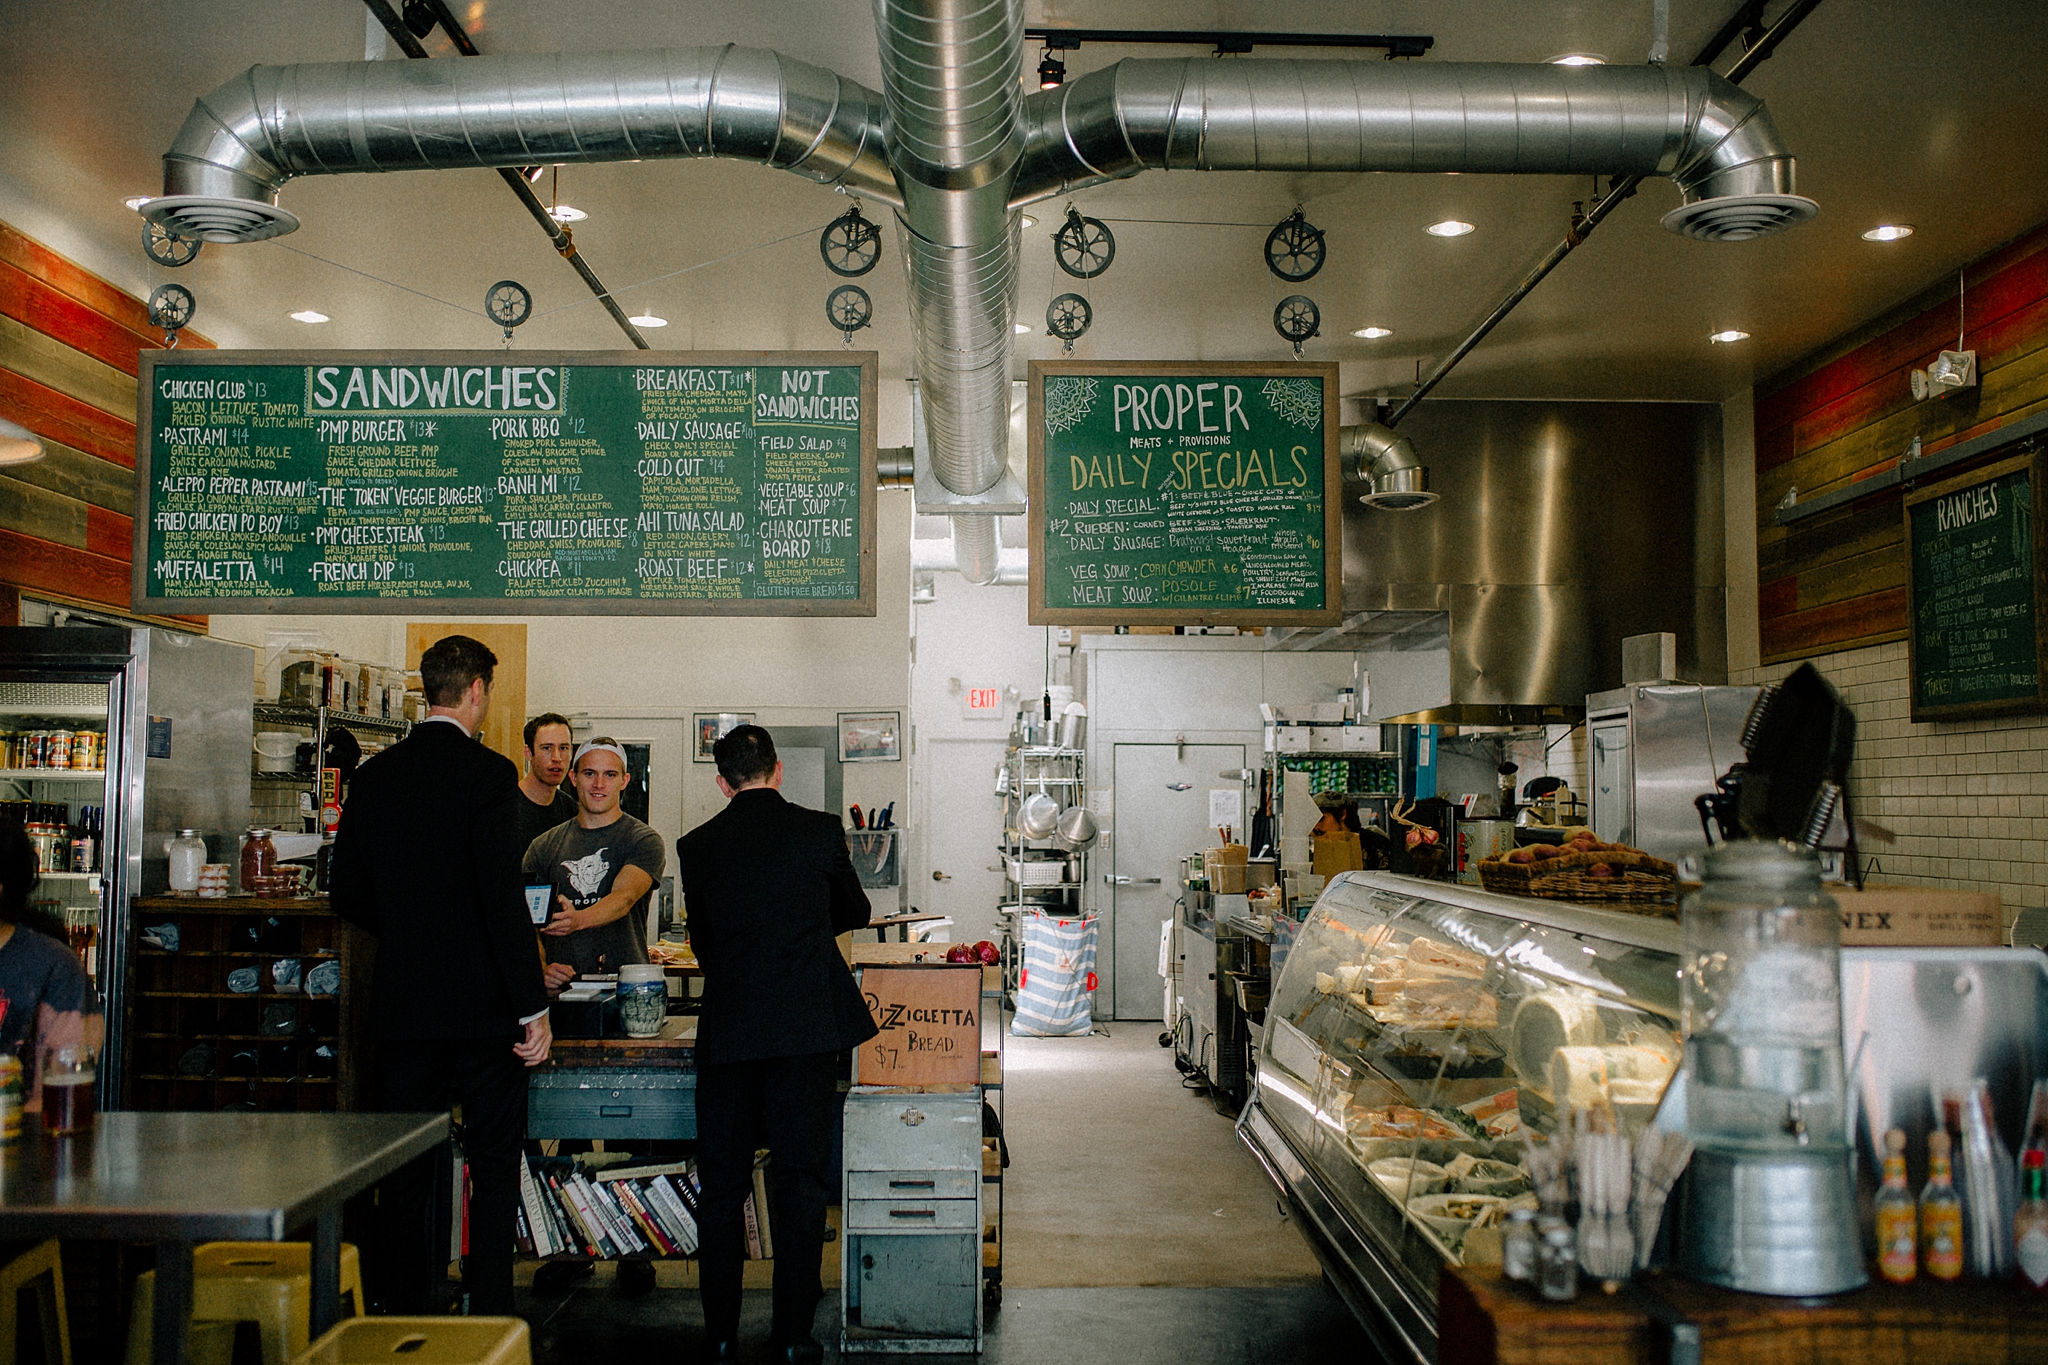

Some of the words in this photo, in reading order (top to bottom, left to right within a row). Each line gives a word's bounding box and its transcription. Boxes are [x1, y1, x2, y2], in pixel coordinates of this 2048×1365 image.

[162, 380, 214, 399] CHICKEN
[217, 382, 245, 399] CLUB
[314, 367, 556, 410] SANDWICHES
[636, 369, 731, 391] BREAKFAST
[782, 370, 830, 395] NOT
[757, 394, 859, 420] SANDWICHES
[1114, 383, 1250, 432] PROPER
[172, 414, 206, 426] PICKLED
[252, 418, 285, 428] RUSTIC
[288, 418, 314, 428] WHITE
[492, 418, 528, 440] PORK
[533, 418, 560, 438] BBQ
[569, 416, 586, 434] $12
[638, 421, 679, 441] DAILY
[683, 421, 741, 440] SAUSAGE
[742, 423, 752, 439] $10
[164, 427, 226, 446] PASTRAMI
[232, 428, 249, 444] $14
[321, 420, 349, 444] PMP
[352, 420, 406, 442] BURGER
[171, 445, 210, 456] GRILLED
[645, 442, 670, 450] CHECK
[700, 441, 738, 449] SPECIAL
[761, 436, 794, 450] FIELD
[799, 436, 832, 450] SALAD
[1130, 437, 1161, 449] MEATS
[1180, 436, 1231, 446] PROVISIONS
[170, 468, 208, 477] GRILLED
[211, 468, 230, 477] RYE
[200, 458, 238, 467] CAROLINA
[638, 459, 672, 477] COLD
[676, 459, 704, 477] CUT
[709, 458, 725, 473] $14
[1070, 452, 1152, 490] DAILY
[1171, 446, 1308, 490] SPECIALS
[162, 476, 205, 493] ALEPPO
[210, 477, 248, 495] PEPPER
[252, 479, 306, 497] PASTRAMI
[306, 477, 318, 495] $15
[498, 475, 536, 495] BANH
[541, 474, 557, 494] MI
[563, 475, 582, 491] $12
[760, 483, 813, 498] VEGETABLE
[817, 482, 844, 498] SOUP
[846, 483, 856, 496] $6
[318, 487, 347, 506] THE
[395, 487, 435, 506] VEGGIE
[439, 486, 482, 506] BURGER
[760, 498, 796, 516] MEAT
[802, 499, 830, 516] SOUP
[832, 498, 847, 514] $7
[1070, 500, 1099, 515] DAILY
[1938, 482, 1998, 532] RANCHES
[158, 513, 186, 531] FRIED
[189, 513, 236, 532] CHICKEN
[242, 514, 255, 532] PO
[259, 515, 283, 534] BOY
[284, 515, 299, 530] $13
[498, 520, 527, 540] THE
[530, 519, 577, 539] GRILLED
[580, 518, 628, 538] CHEESE
[628, 530, 638, 547] $8
[637, 511, 660, 532] AHI
[663, 511, 701, 532] TUNA
[703, 511, 744, 532] SALAD
[736, 533, 751, 547] $12
[760, 518, 853, 539] CHARCUTERIE
[1050, 519, 1071, 536] #2
[231, 532, 259, 542] SMOKED
[316, 526, 340, 545] PMP
[429, 525, 445, 541] $13
[646, 533, 663, 541] RED
[1071, 537, 1105, 551] DAILY
[1307, 535, 1320, 549] $10
[232, 552, 253, 560] ROLL
[763, 539, 810, 558] BOARD
[816, 538, 831, 553] $18
[157, 560, 256, 581] MUFFALETTA
[263, 554, 283, 575] $14
[313, 562, 367, 582] FRENCH
[374, 562, 395, 581] DIP
[399, 561, 414, 578] $13
[498, 559, 561, 578] CHICKPEA
[568, 562, 581, 576] $11
[639, 558, 683, 578] ROAST
[688, 559, 728, 578] BEEF
[765, 560, 785, 569] DAILY
[788, 559, 808, 568] MEAT
[1070, 564, 1097, 579] VEG
[1140, 563, 1166, 578] CORN
[1167, 559, 1217, 576] CHOWDER
[1224, 564, 1238, 573] $6
[551, 578, 583, 587] PICKLED
[757, 586, 790, 596] GLUTEN
[792, 587, 810, 596] FREE
[812, 586, 836, 597] BREAD
[1073, 584, 1115, 603] MEAT
[1162, 580, 1217, 592] POSOLE
[1236, 586, 1250, 599] $7
[1925, 678, 1953, 697] TURKEY
[971, 689, 996, 708] EXIT
[324, 772, 335, 798] RED
[907, 1031, 953, 1052] BREAD
[875, 1044, 898, 1069] $7
[526, 1189, 545, 1234] HARVEST
[746, 1215, 757, 1242] FIRES
